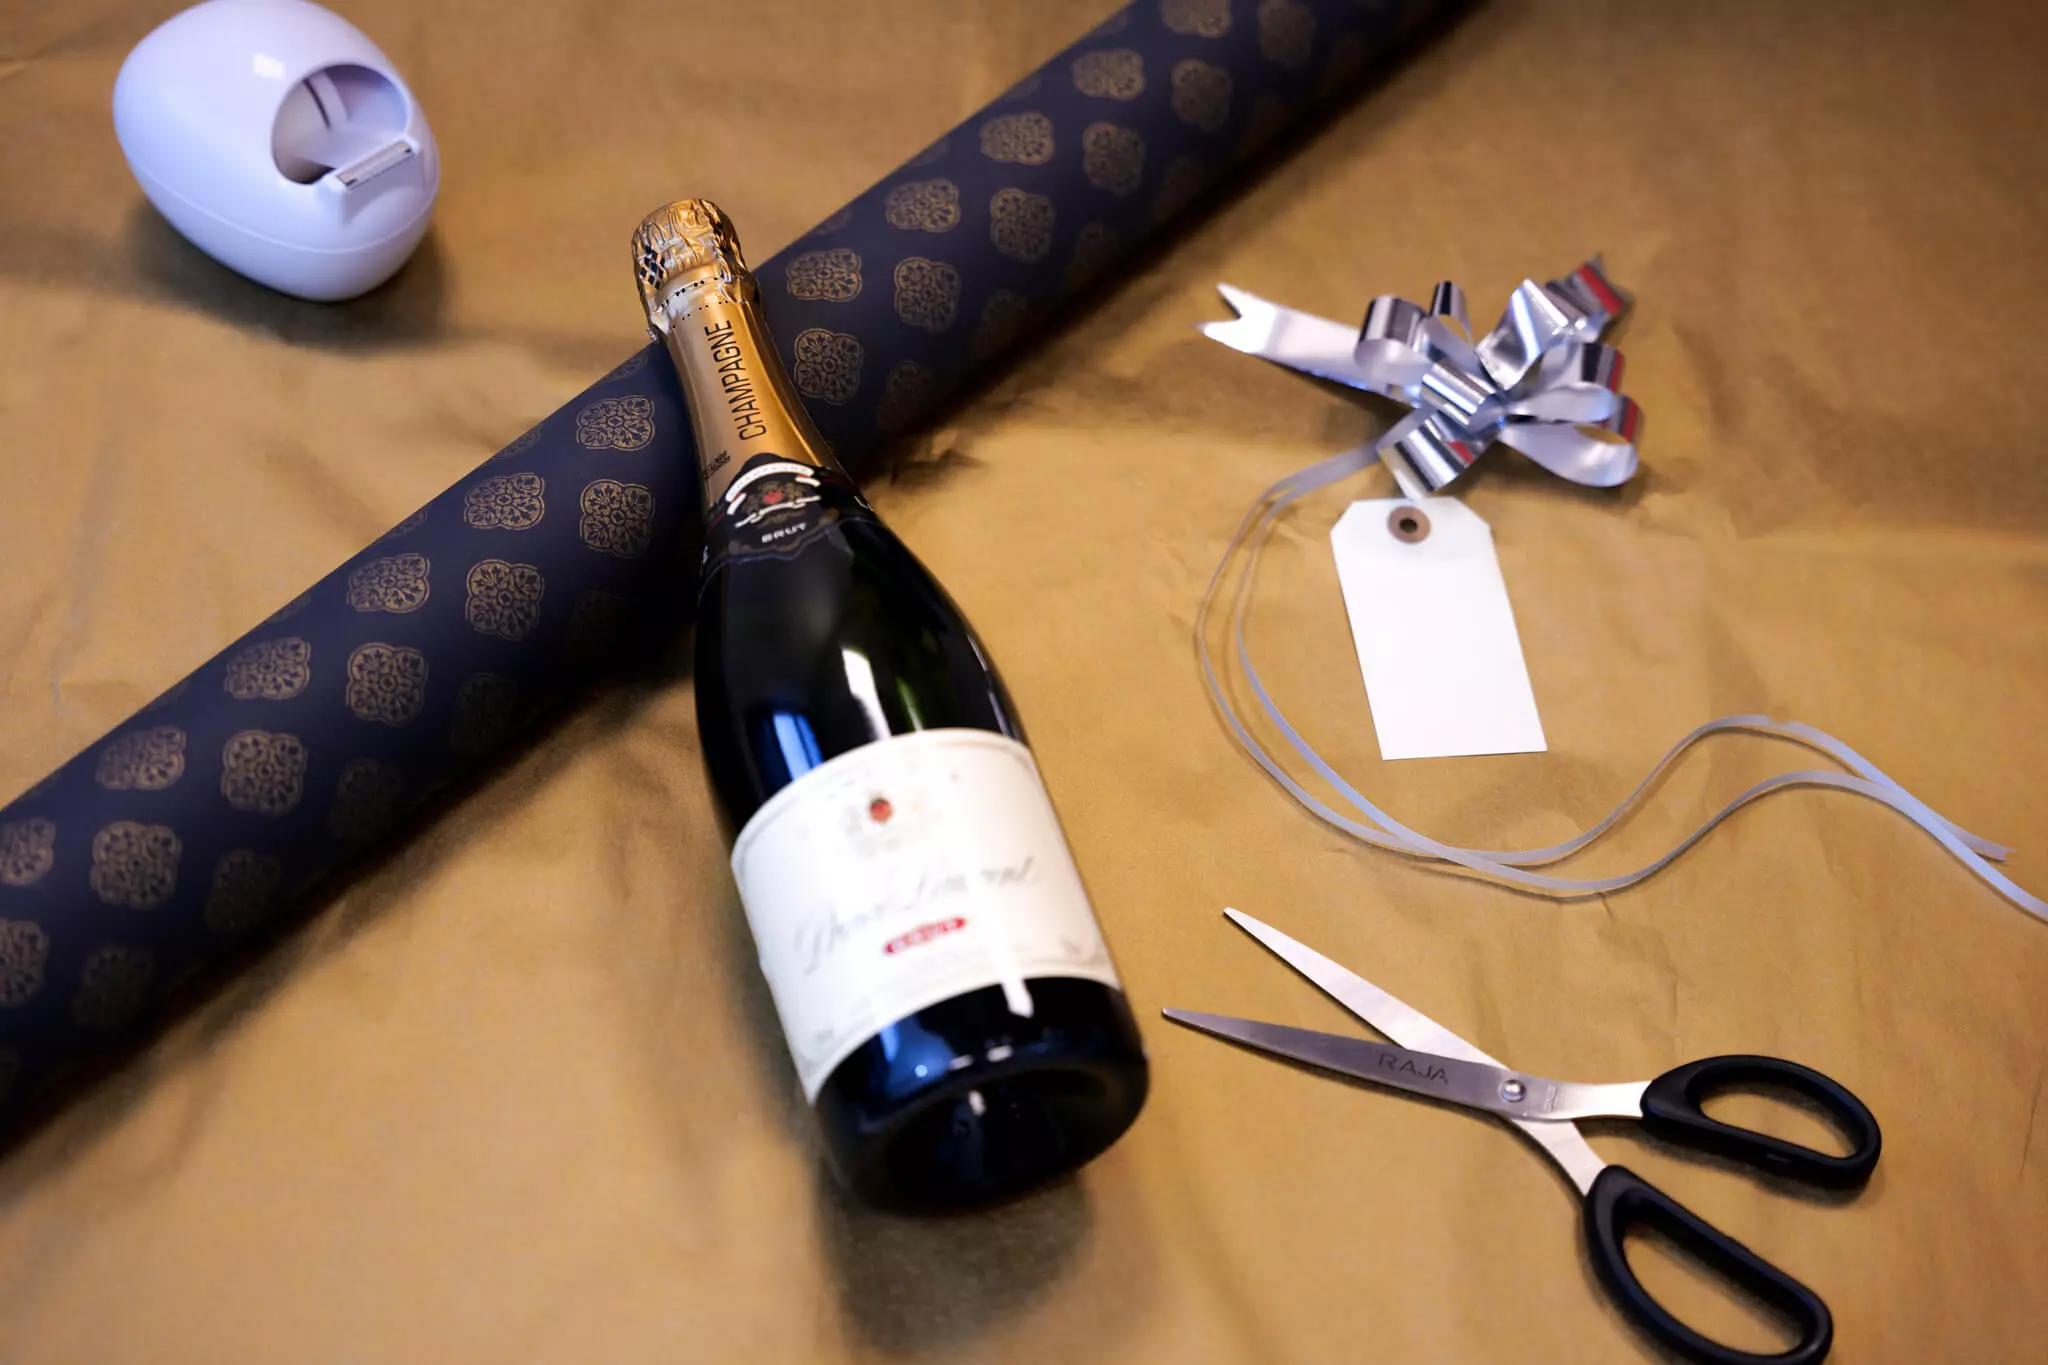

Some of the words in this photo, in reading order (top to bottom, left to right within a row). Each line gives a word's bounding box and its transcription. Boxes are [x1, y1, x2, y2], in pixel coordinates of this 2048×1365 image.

[704, 320, 767, 440] CHAMPAGNE
[761, 522, 806, 543] BRUT
[1378, 1053, 1449, 1084] RAJA
